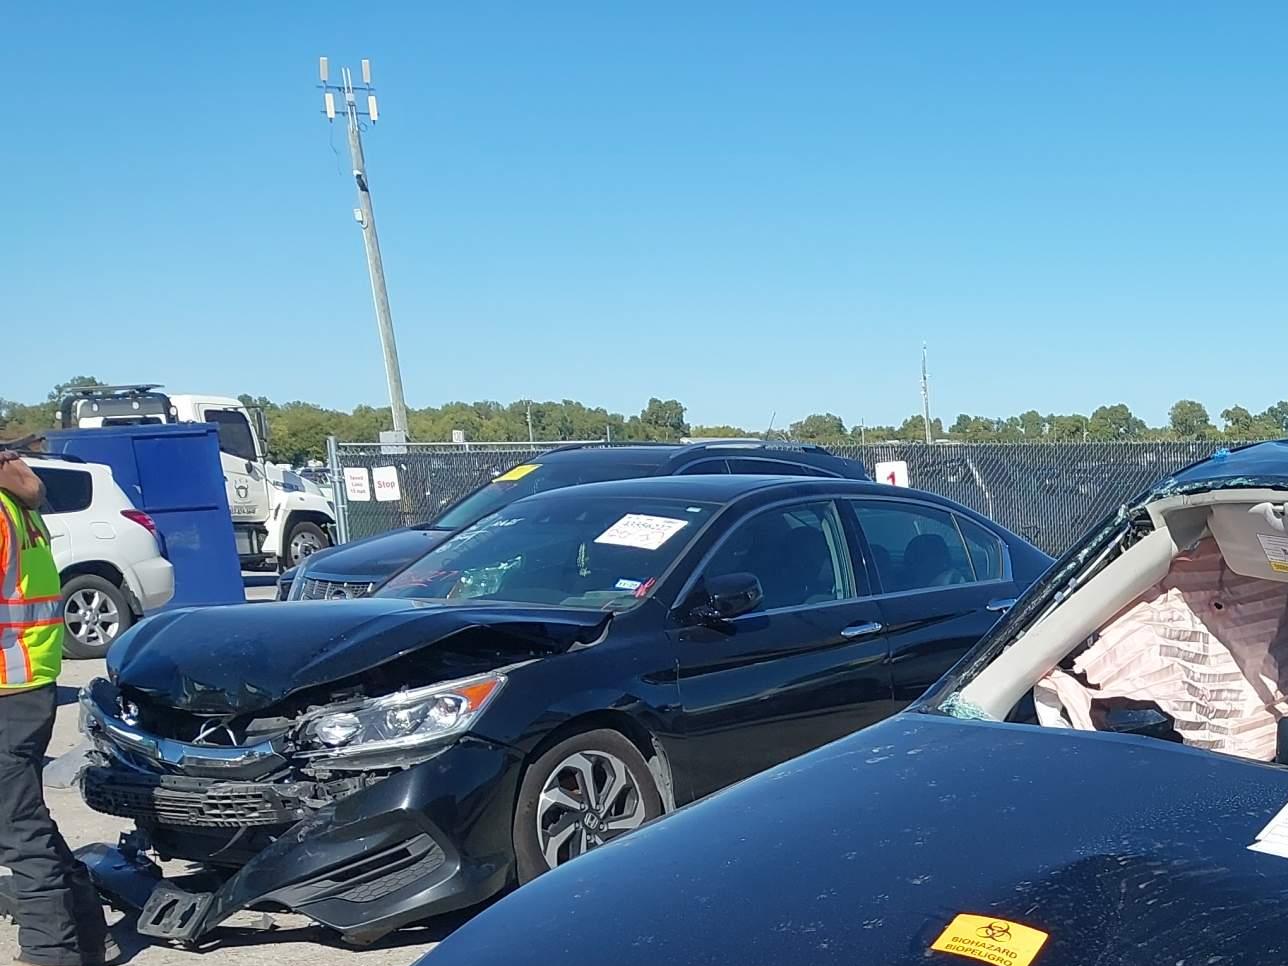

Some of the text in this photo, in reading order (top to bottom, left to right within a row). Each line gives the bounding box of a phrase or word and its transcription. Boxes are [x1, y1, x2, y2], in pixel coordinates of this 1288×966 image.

[377, 480, 396, 489] Stop
[944, 943, 1014, 966] BIOPELIGRO
[951, 936, 1018, 959] BIOHAZARD
